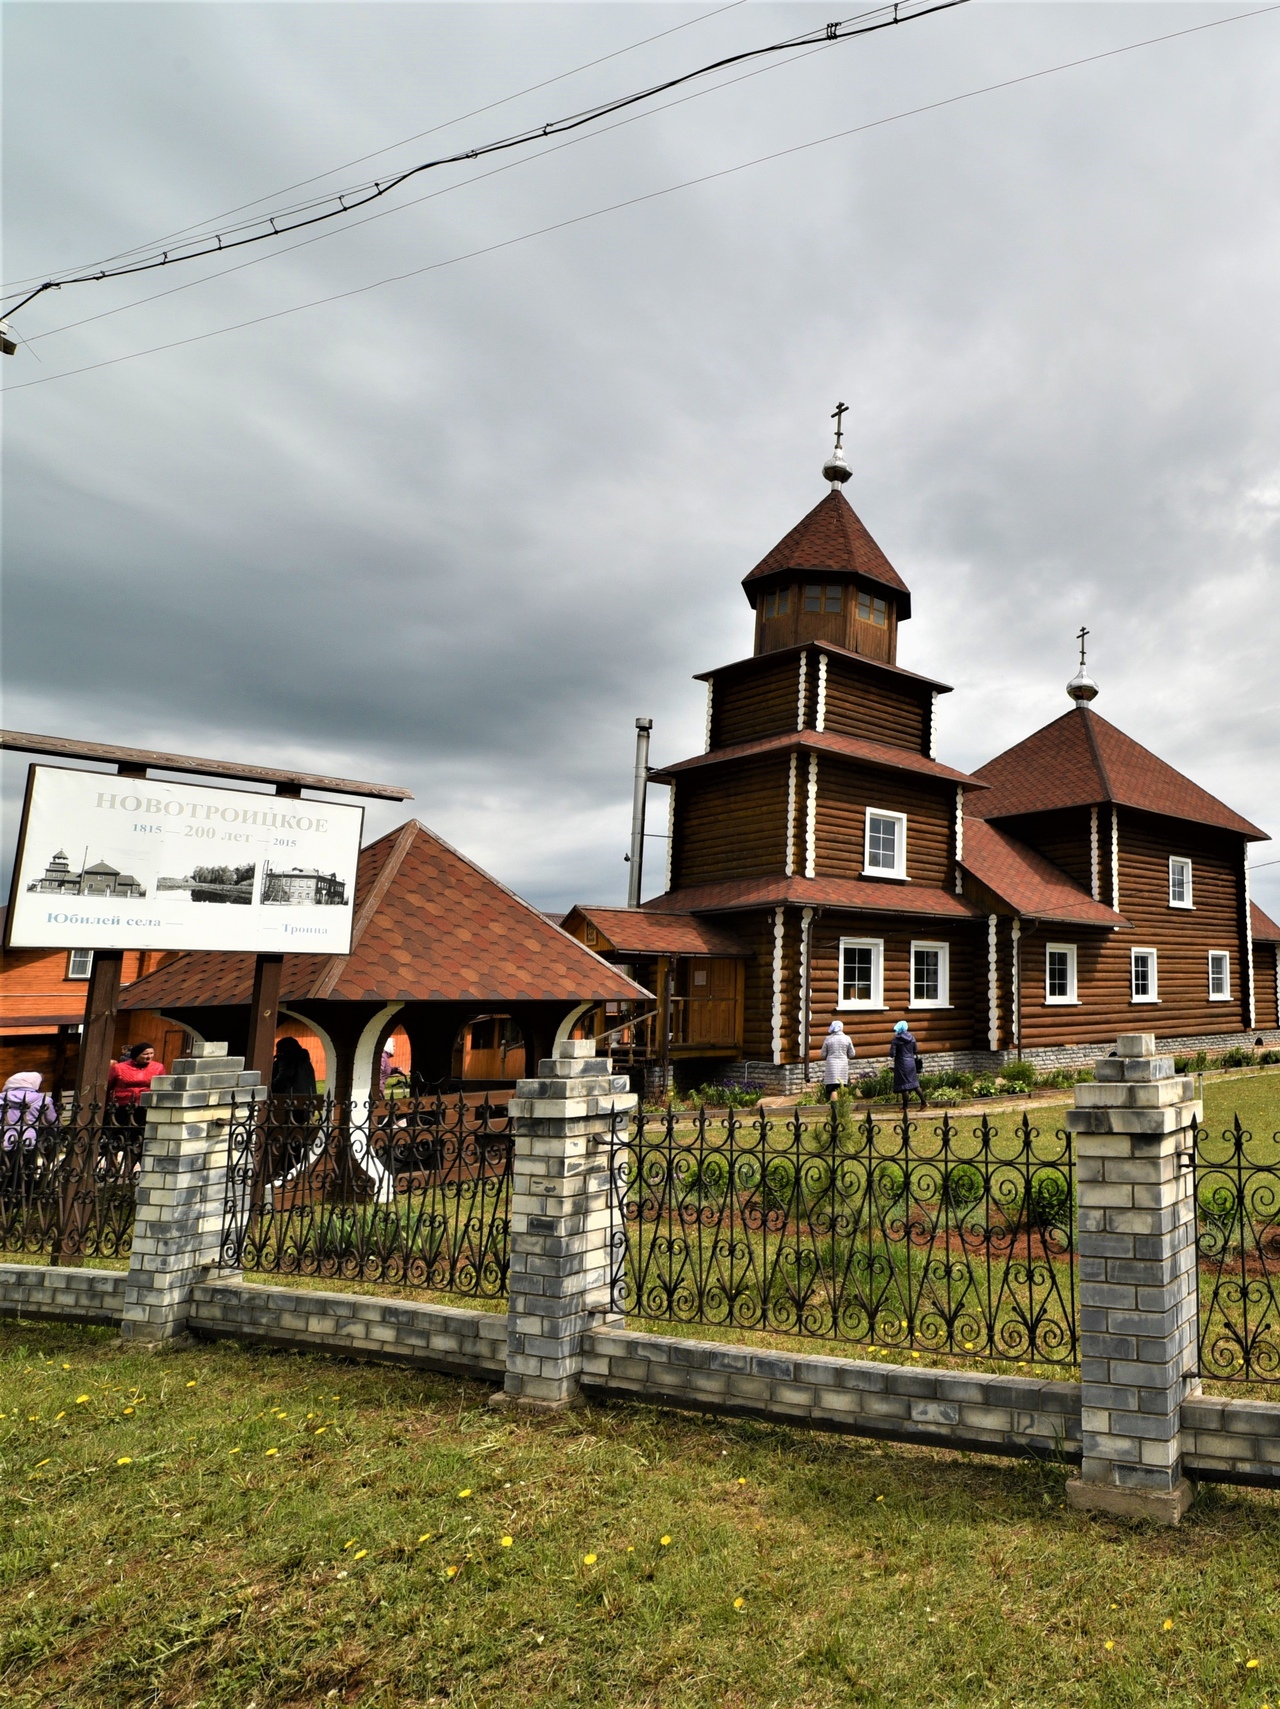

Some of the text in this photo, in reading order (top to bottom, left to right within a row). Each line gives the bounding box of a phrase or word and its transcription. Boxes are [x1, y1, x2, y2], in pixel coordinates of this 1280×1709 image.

[94, 792, 328, 833] НОВОТРОИЦКОЕ
[132, 823, 163, 834] 1815
[183, 824, 216, 840] 200
[221, 831, 253, 844] лет
[273, 837, 297, 848] 2015
[47, 912, 121, 926] Юбилей
[126, 917, 162, 927] села
